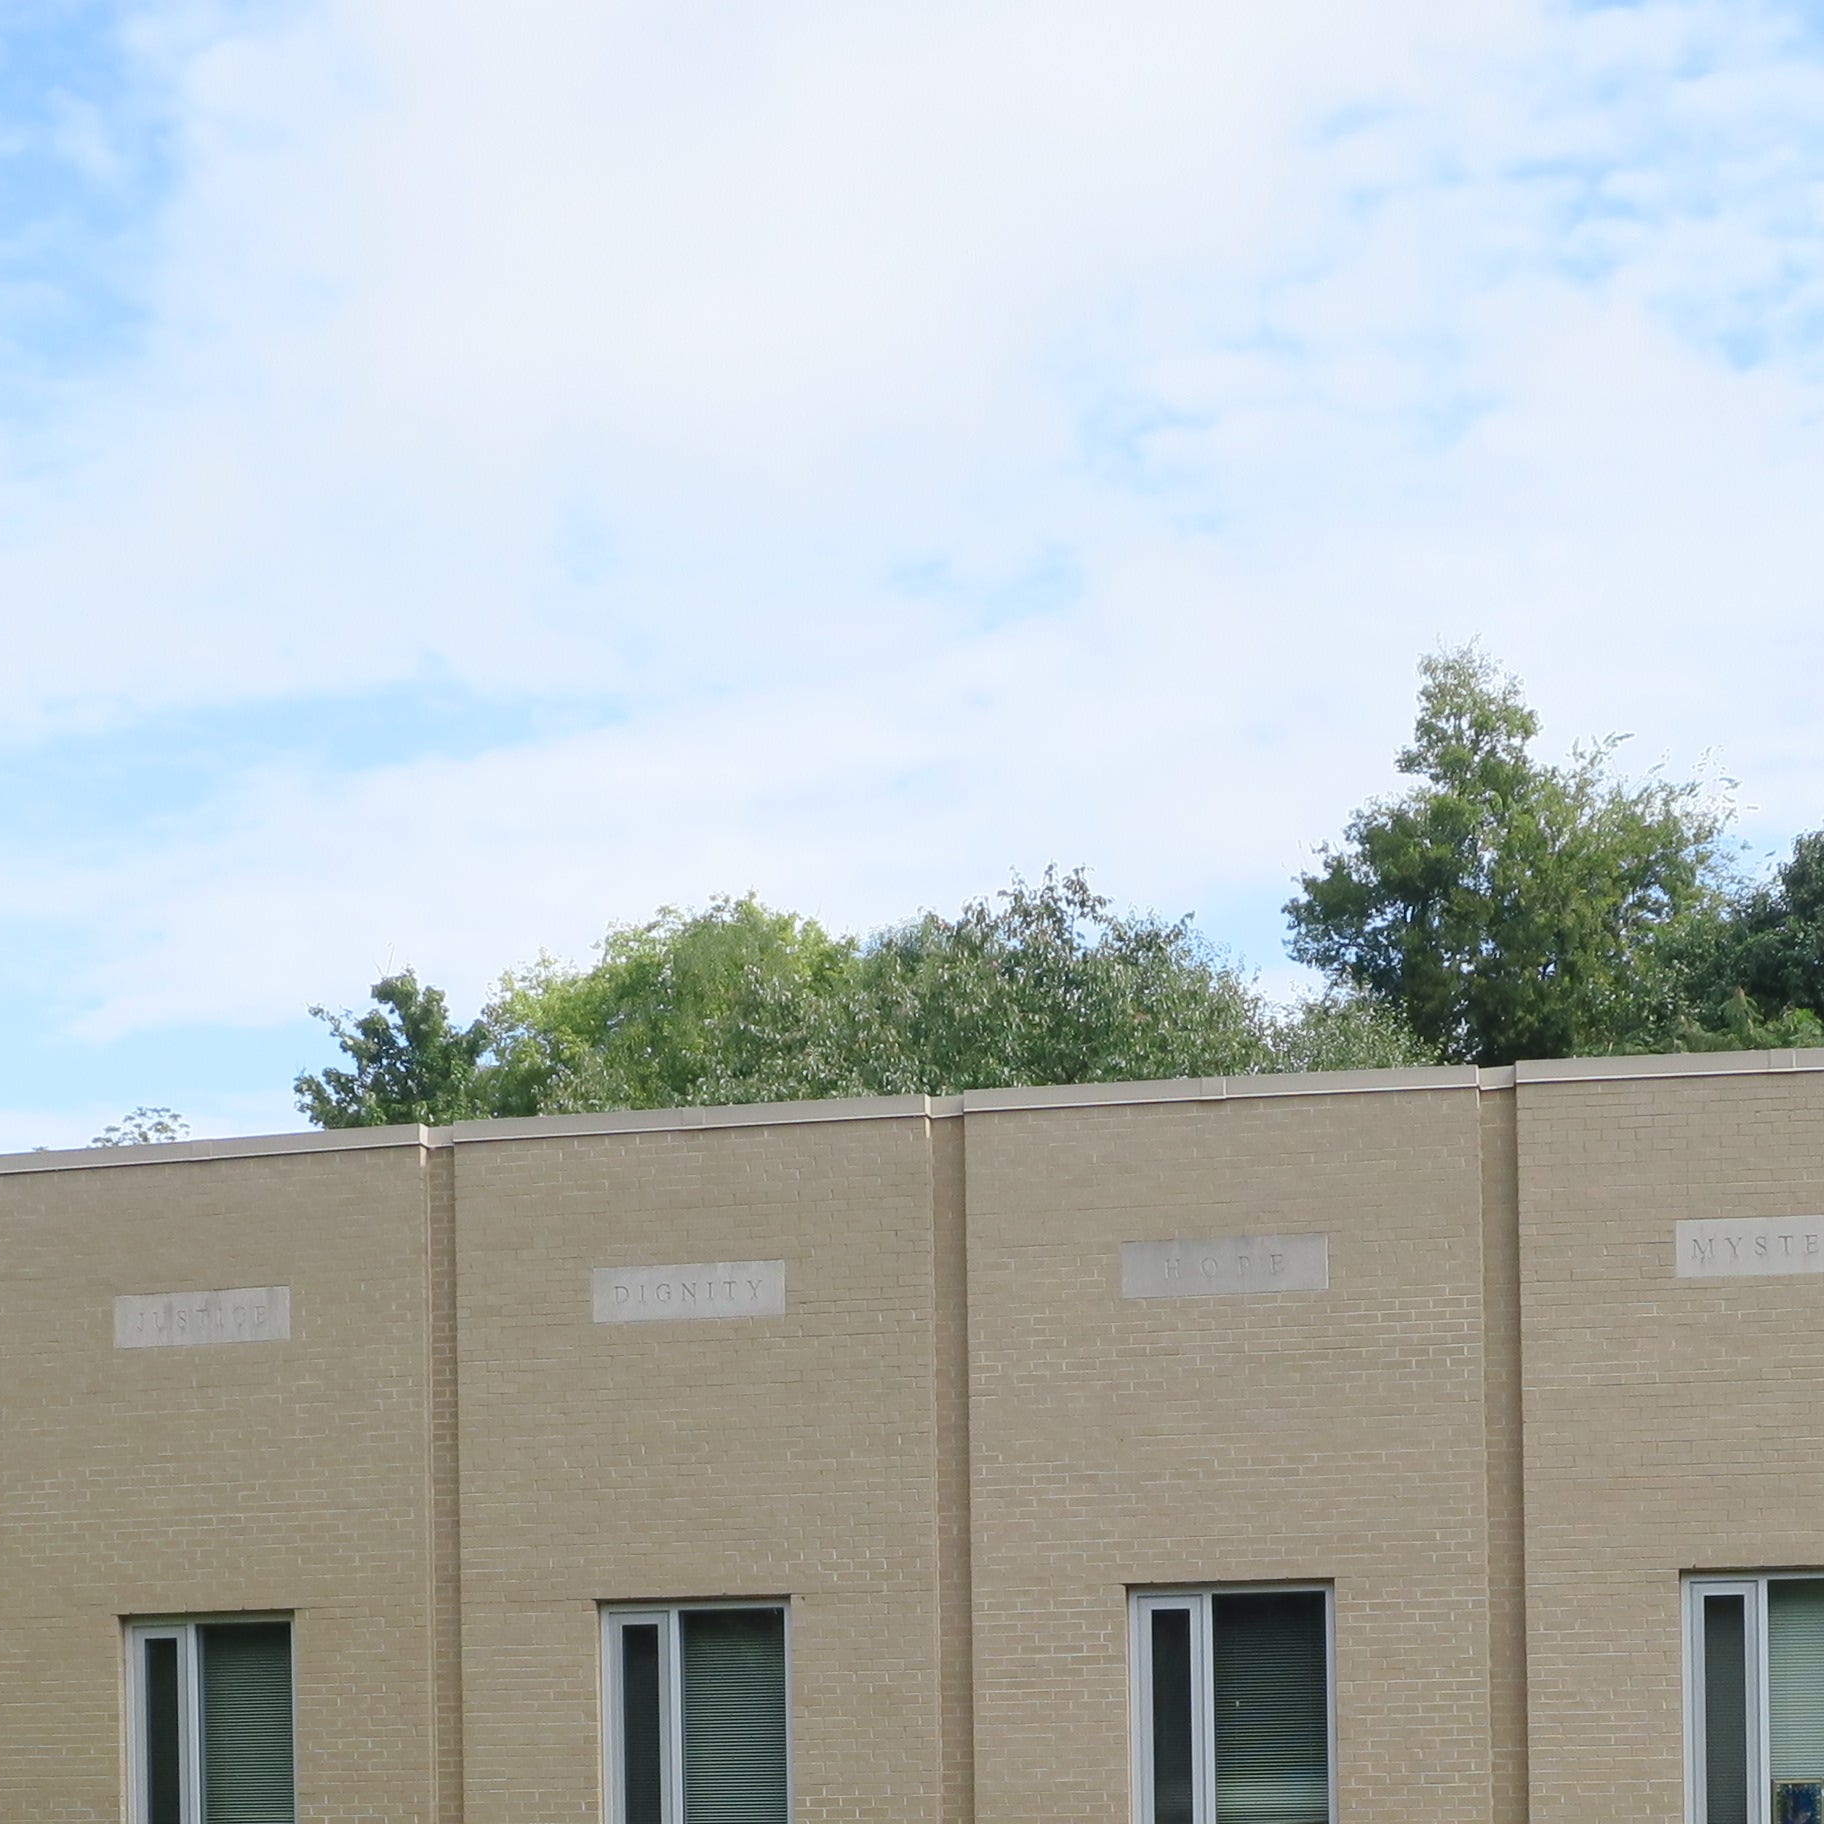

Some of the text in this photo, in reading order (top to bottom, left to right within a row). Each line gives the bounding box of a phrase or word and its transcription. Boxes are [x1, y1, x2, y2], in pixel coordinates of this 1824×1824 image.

[1164, 1253, 1284, 1281] HOPE
[613, 1279, 764, 1305] DIGNITY
[135, 1305, 266, 1332] JUSTICE
